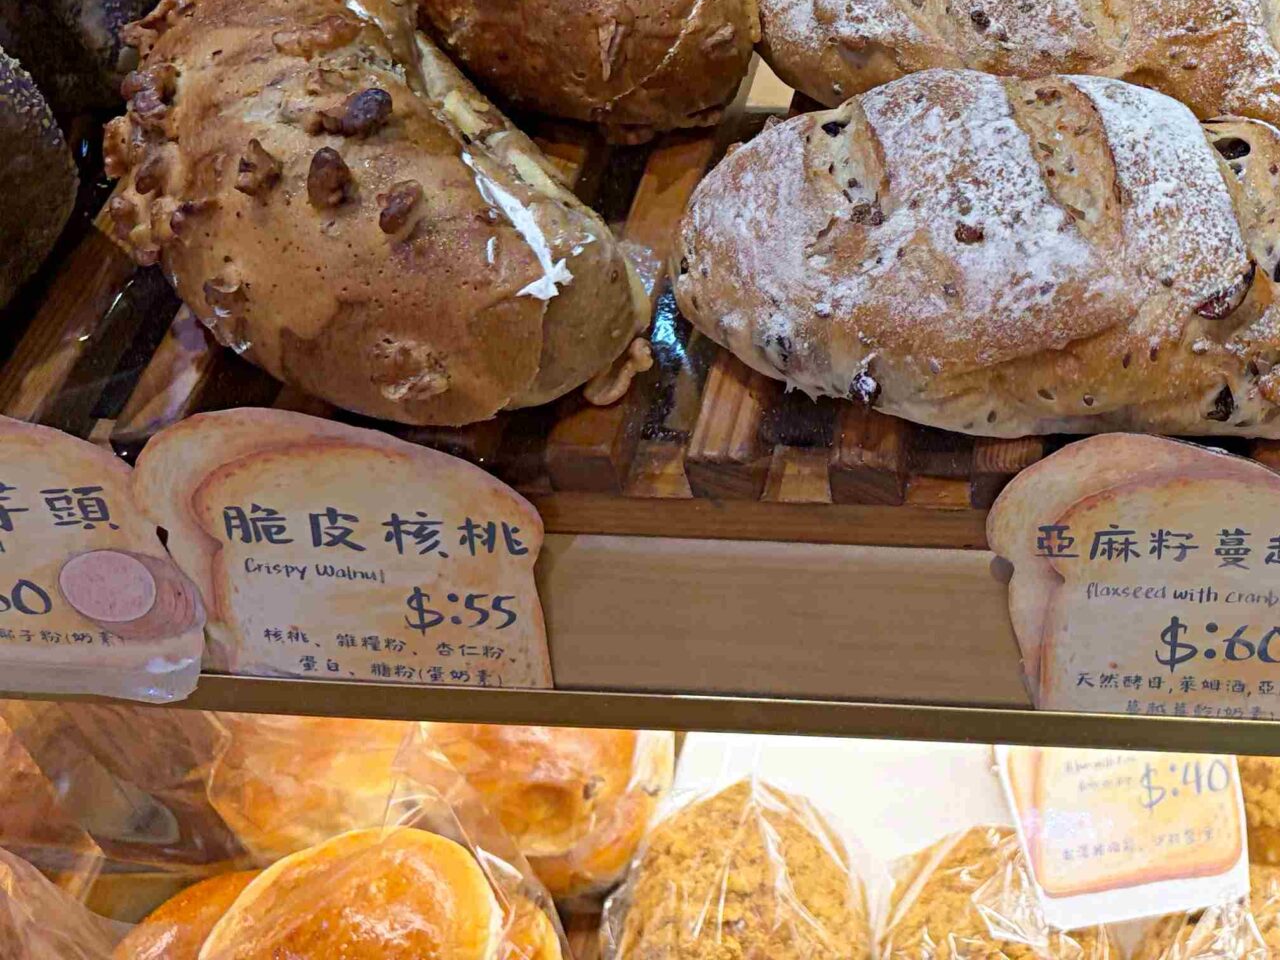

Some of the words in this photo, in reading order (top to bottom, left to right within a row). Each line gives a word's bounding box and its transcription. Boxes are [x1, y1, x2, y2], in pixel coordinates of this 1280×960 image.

[223, 504, 530, 558] 脆皮核桃
[244, 557, 307, 580] Crispy
[1086, 582, 1167, 600] flaxseed
[1173, 586, 1219, 603] with
